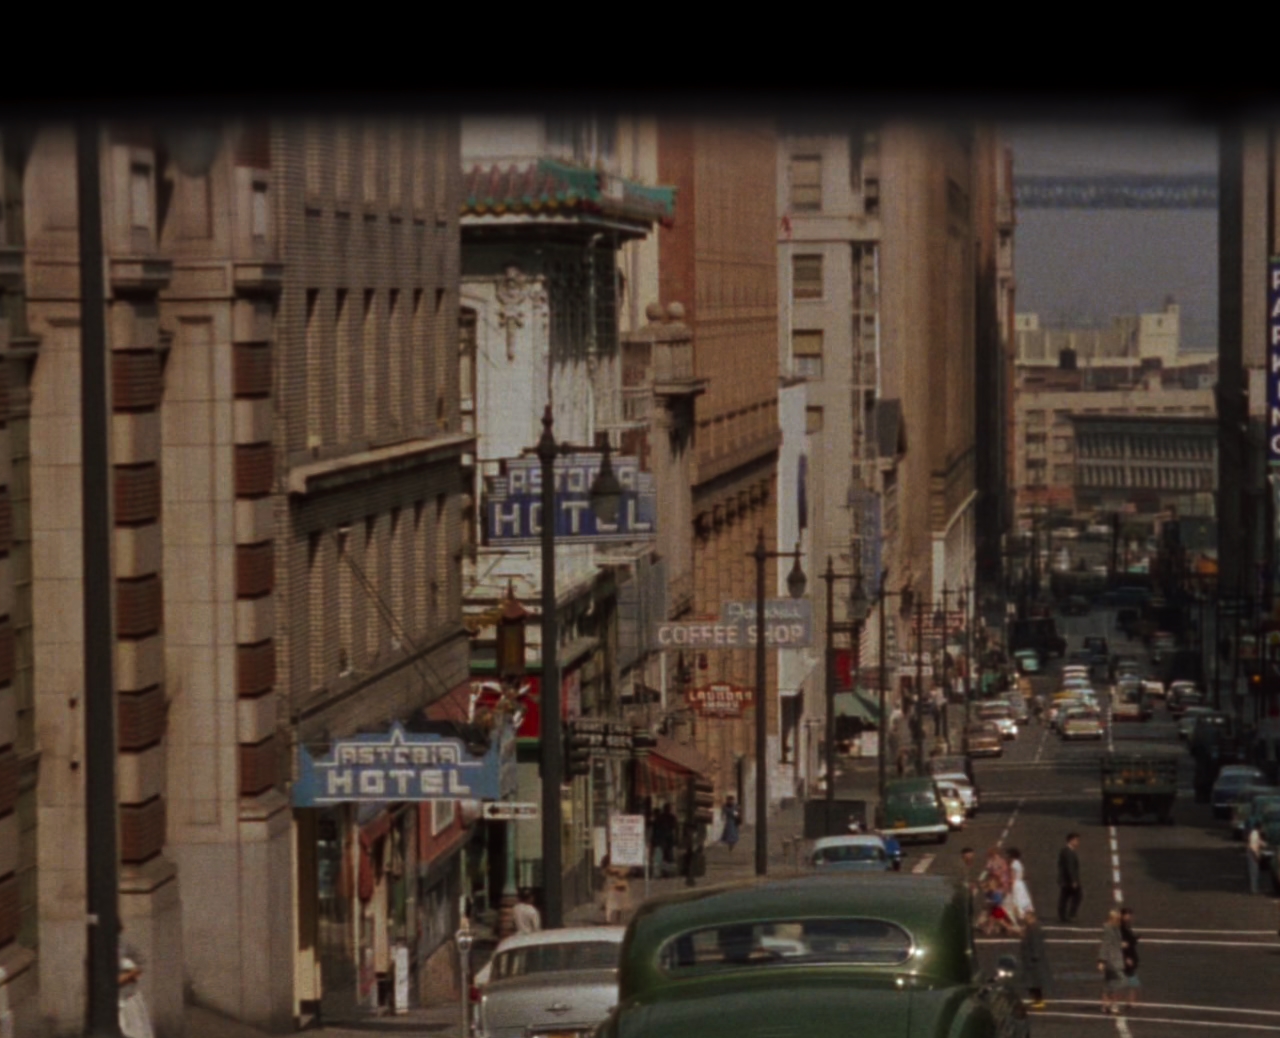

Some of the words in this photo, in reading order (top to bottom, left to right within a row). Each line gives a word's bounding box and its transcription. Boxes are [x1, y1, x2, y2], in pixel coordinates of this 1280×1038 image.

[508, 465, 636, 495] ASTORA
[658, 625, 738, 645] COFFEE
[327, 769, 471, 795] HOTEL
